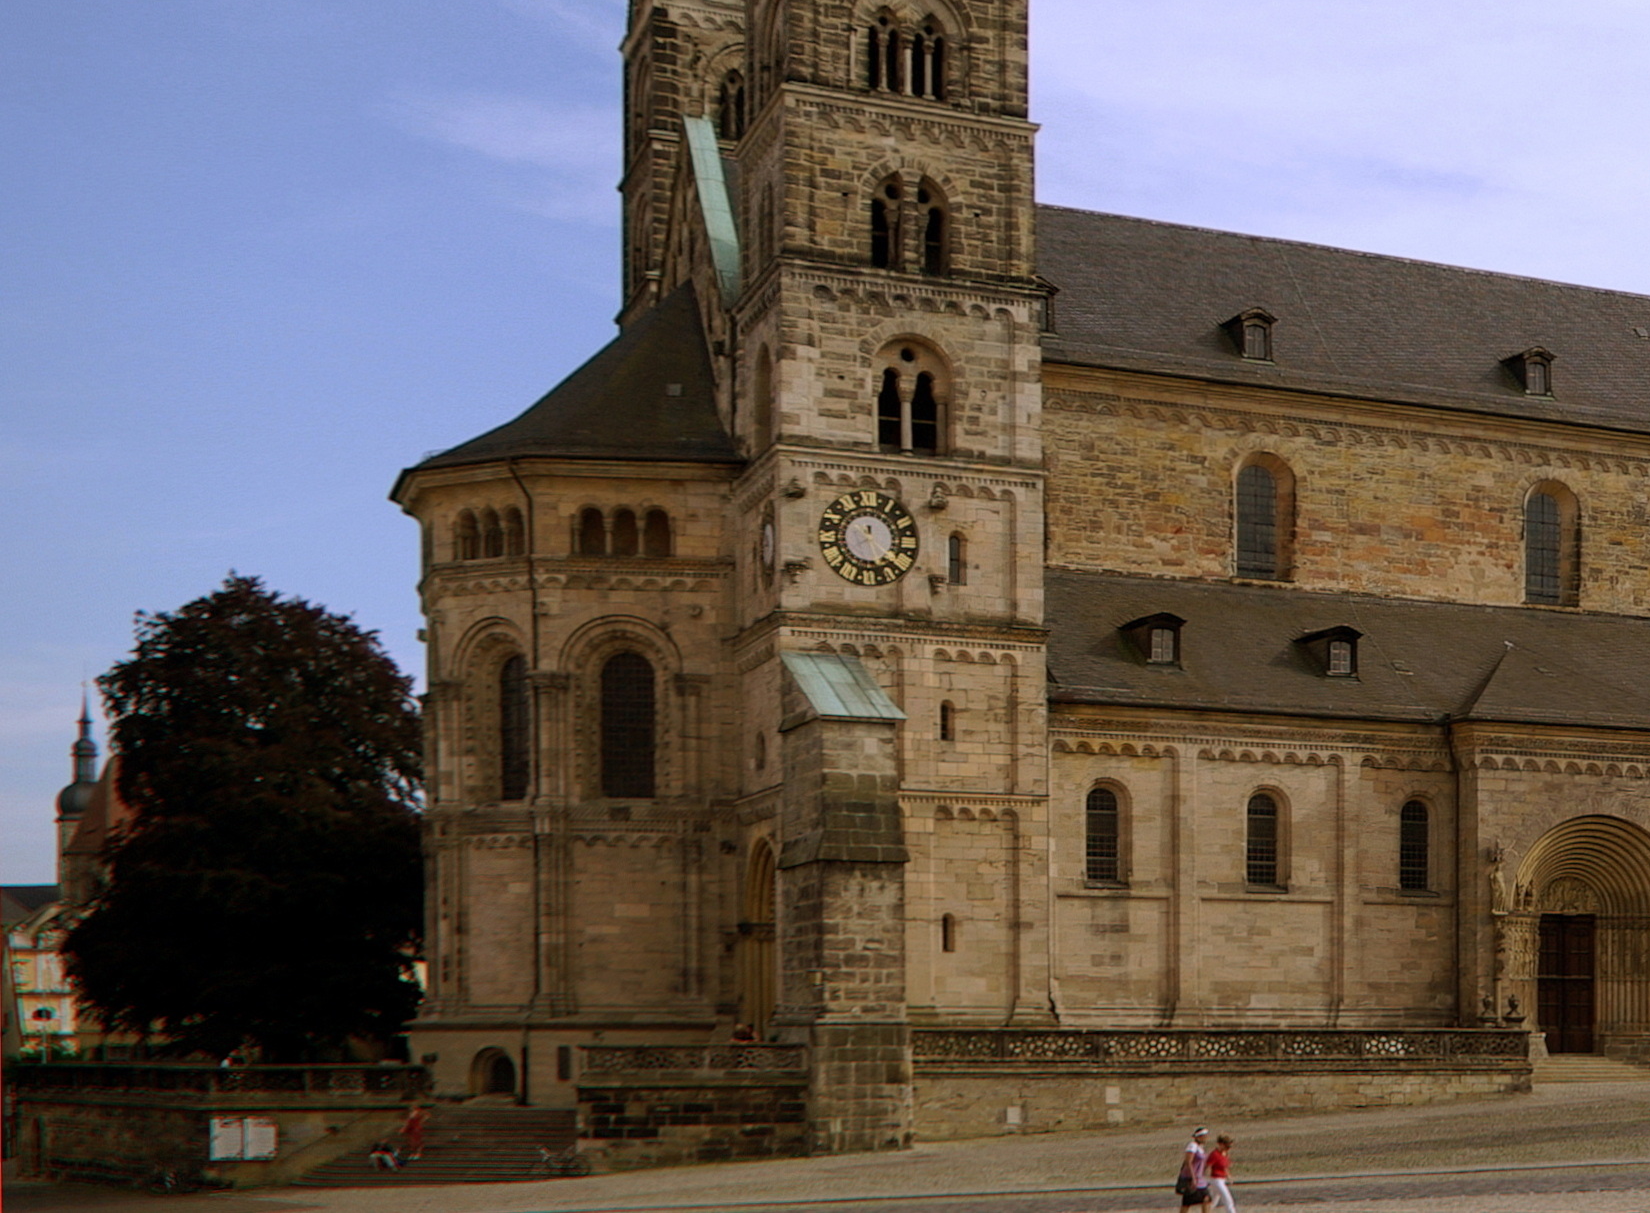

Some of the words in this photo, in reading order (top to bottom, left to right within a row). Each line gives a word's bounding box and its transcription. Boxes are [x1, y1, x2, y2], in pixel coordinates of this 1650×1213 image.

[839, 494, 857, 512] XI
[860, 491, 877, 506] XII
[884, 499, 894, 513] I
[824, 509, 842, 524] X
[897, 516, 912, 529] II
[819, 530, 836, 542] IX
[901, 537, 916, 548] III
[823, 546, 843, 566] VIII
[839, 562, 857, 580] VII
[863, 570, 875, 585] VI
[883, 567, 896, 581] V
